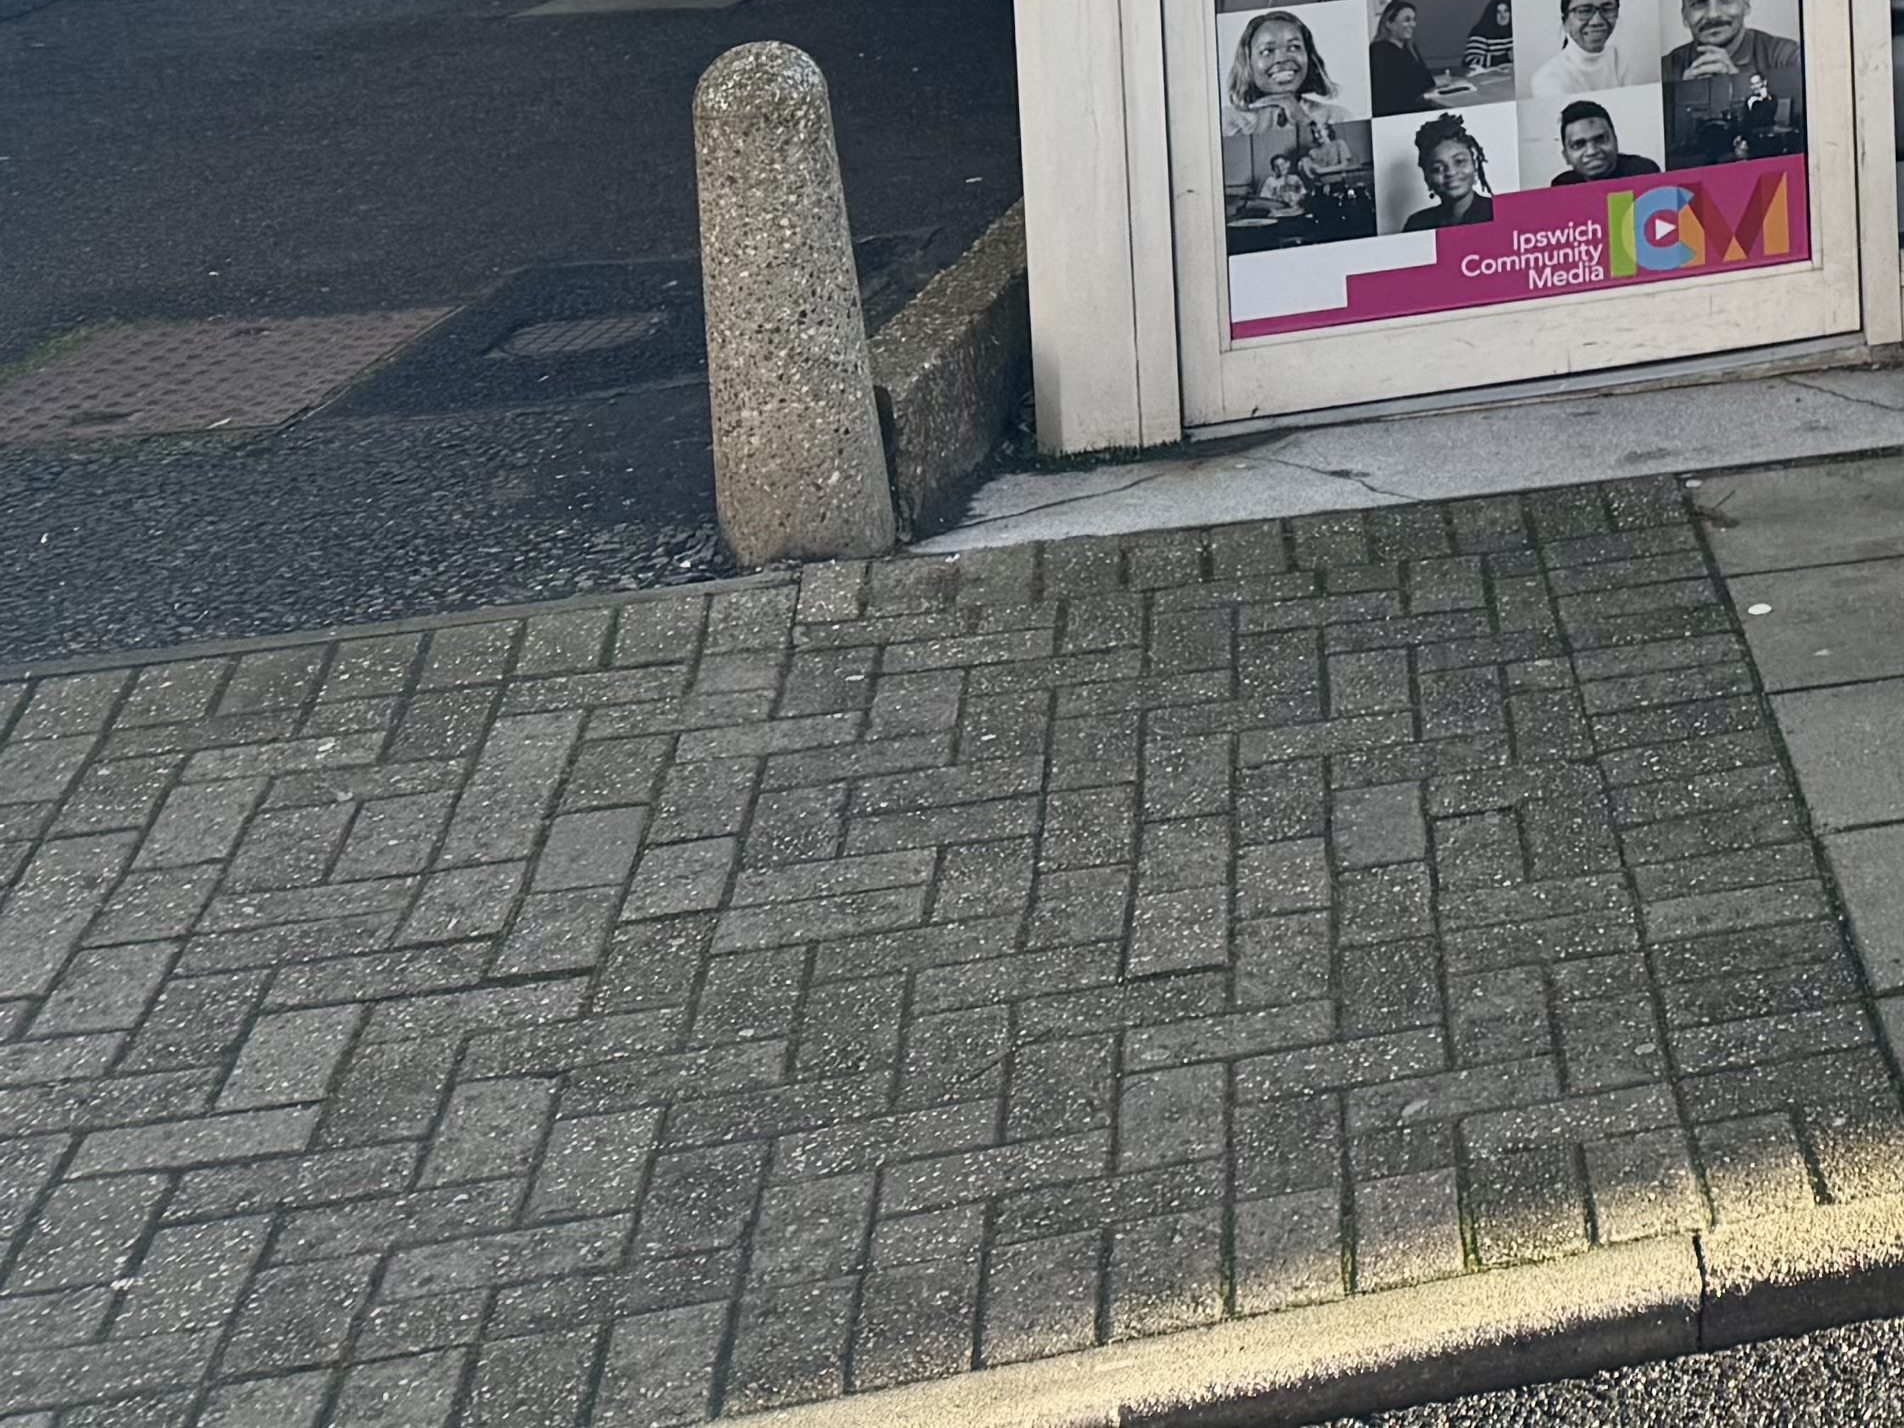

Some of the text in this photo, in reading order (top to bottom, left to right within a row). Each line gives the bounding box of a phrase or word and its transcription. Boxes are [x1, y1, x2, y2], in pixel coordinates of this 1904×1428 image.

[1512, 219, 1602, 253] Ipswich
[1607, 170, 1791, 279] ICM
[1461, 242, 1604, 277] Community
[1527, 264, 1605, 290] Media
